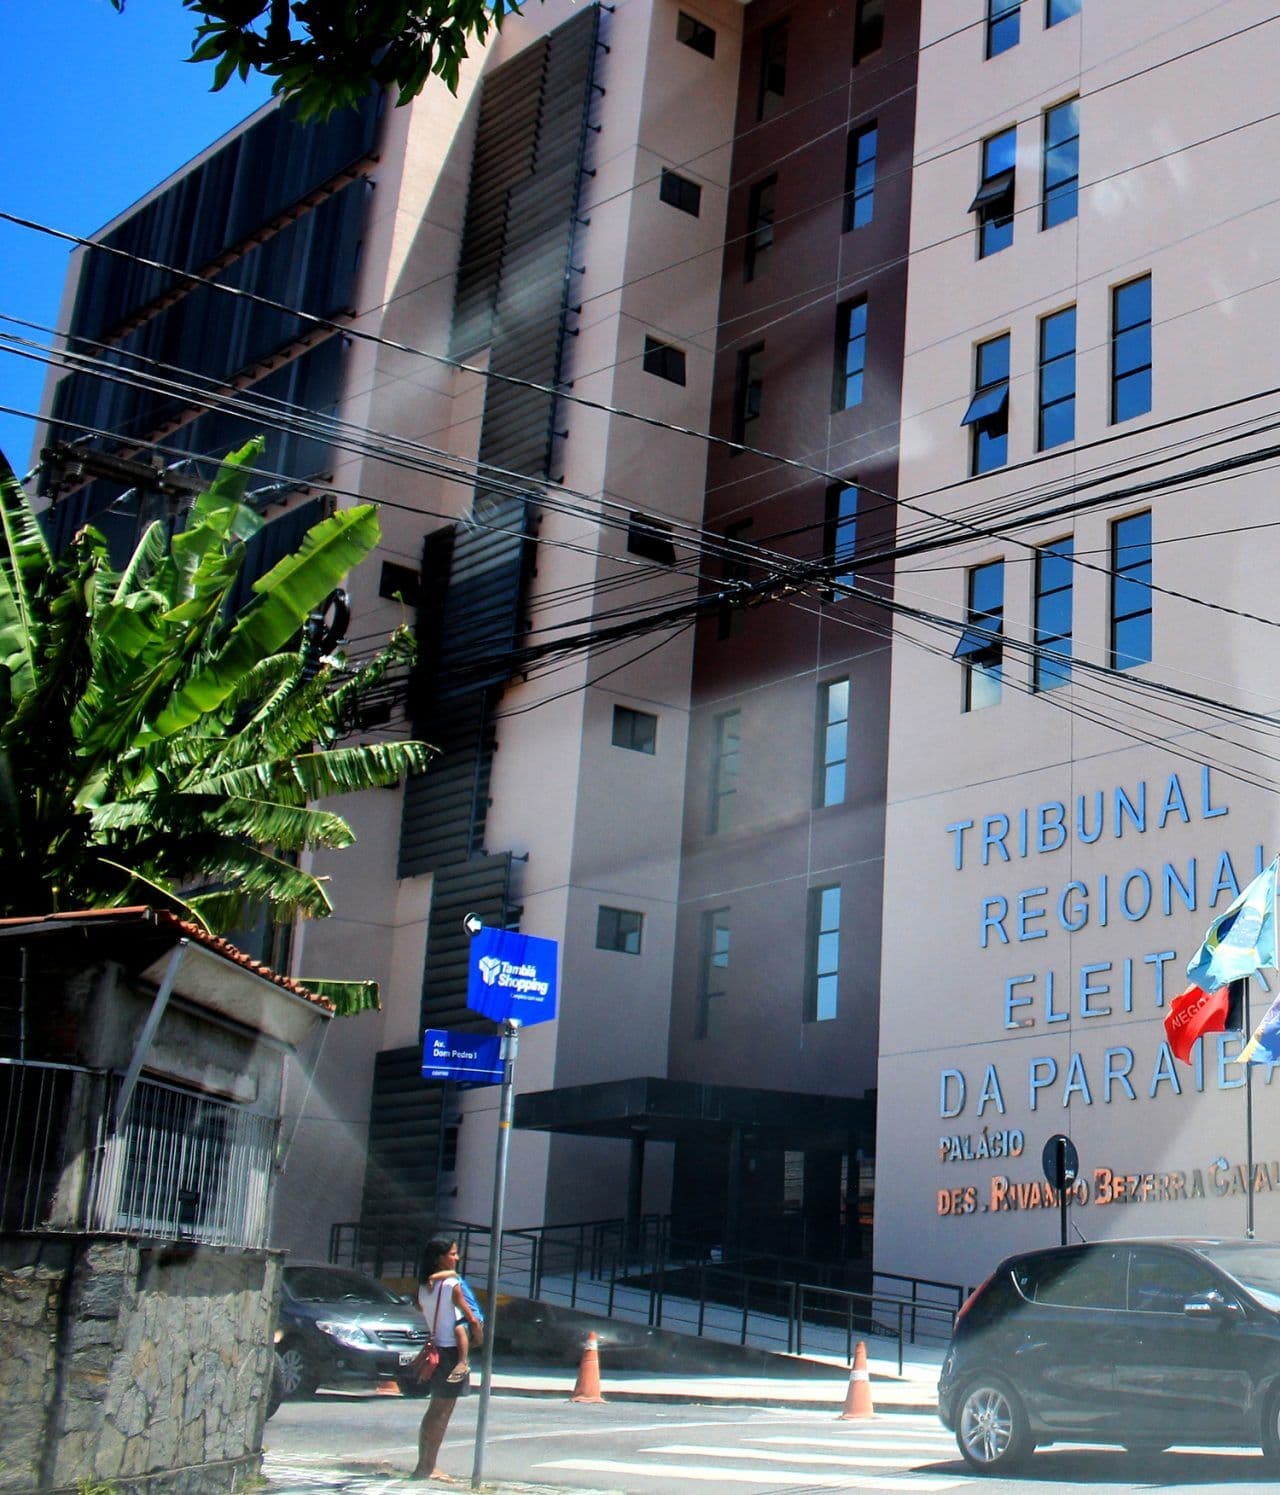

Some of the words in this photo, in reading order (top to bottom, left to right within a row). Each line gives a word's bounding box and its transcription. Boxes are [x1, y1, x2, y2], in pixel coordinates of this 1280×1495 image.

[946, 766, 1229, 871] TRIBUNAL
[498, 973, 549, 995] Shopping
[1171, 997, 1210, 1030] NEGO
[433, 1049, 450, 1057] Dom
[452, 1050, 473, 1059] Pedro
[940, 1064, 1006, 1120] DA
[938, 1126, 1025, 1162] PALÁCIO
[1094, 1167, 1206, 1206] BEZERRA
